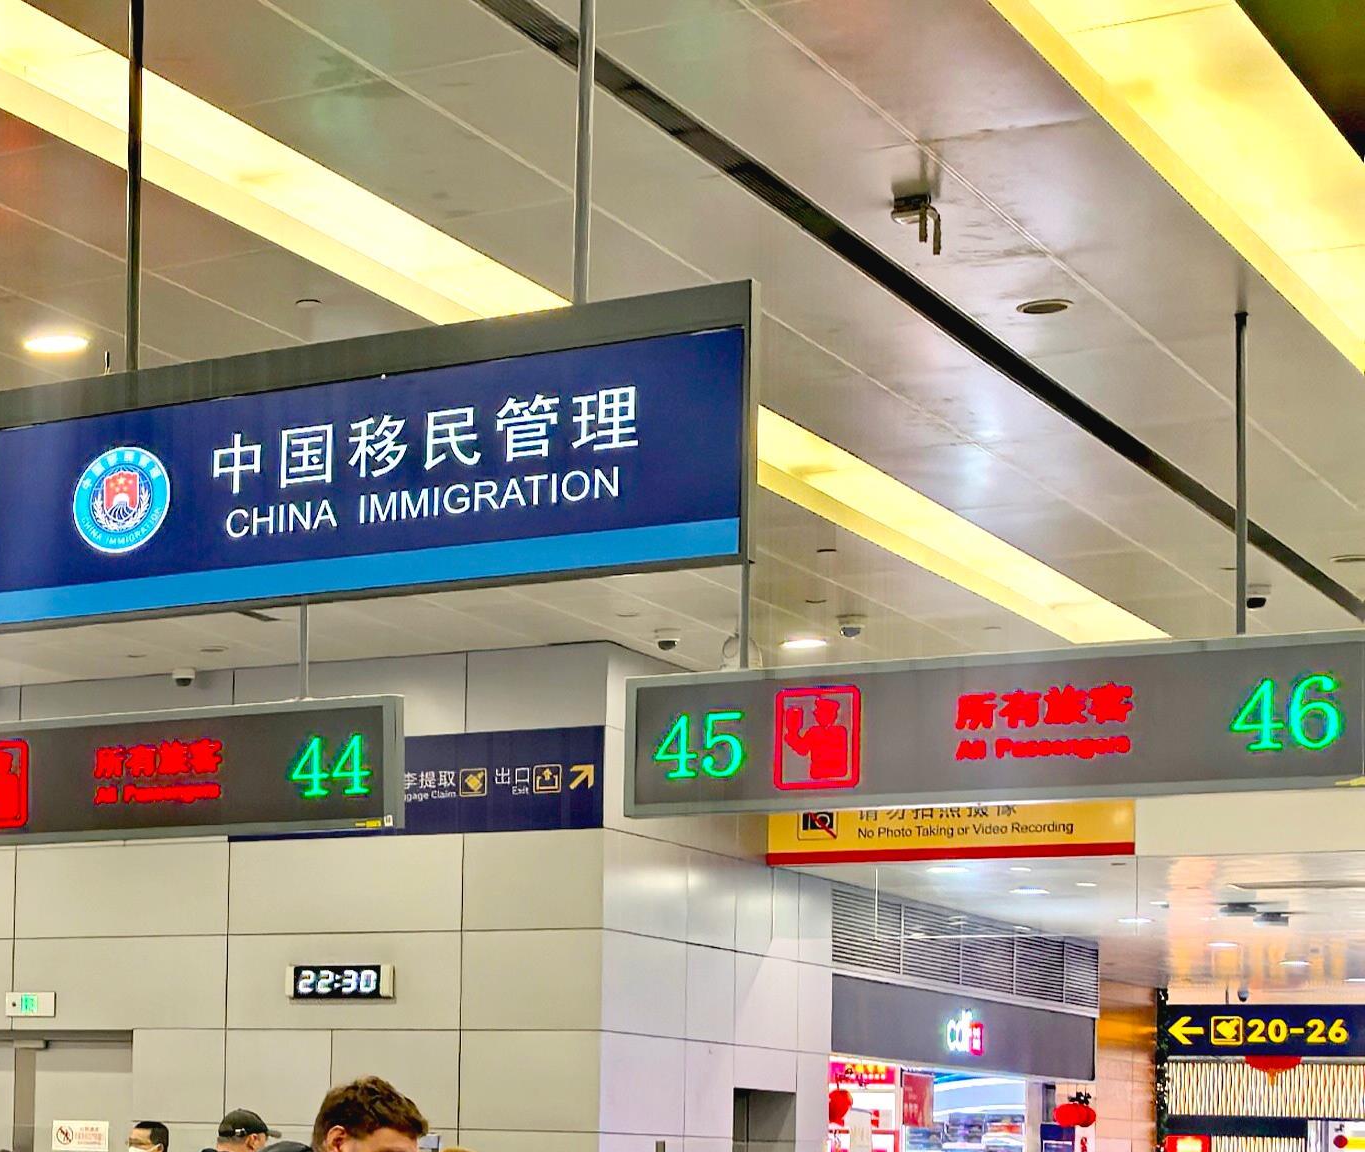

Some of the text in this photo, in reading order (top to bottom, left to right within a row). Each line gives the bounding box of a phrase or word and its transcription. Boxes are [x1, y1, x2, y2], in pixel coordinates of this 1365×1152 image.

[211, 384, 640, 495] 中国移民管理
[226, 466, 620, 539] CHINA IMMIGRATION
[956, 682, 1135, 732] 所有旅客
[1228, 672, 1344, 754] 46
[655, 710, 744, 780] 45
[291, 732, 372, 798] 44
[404, 767, 530, 790] 李提取 出口
[431, 790, 457, 799] Claim
[512, 786, 529, 795] Exit
[858, 820, 1074, 839] No Photo Taking or Video Recording
[297, 969, 378, 994] 22:30
[1247, 1018, 1349, 1044] 20-26
